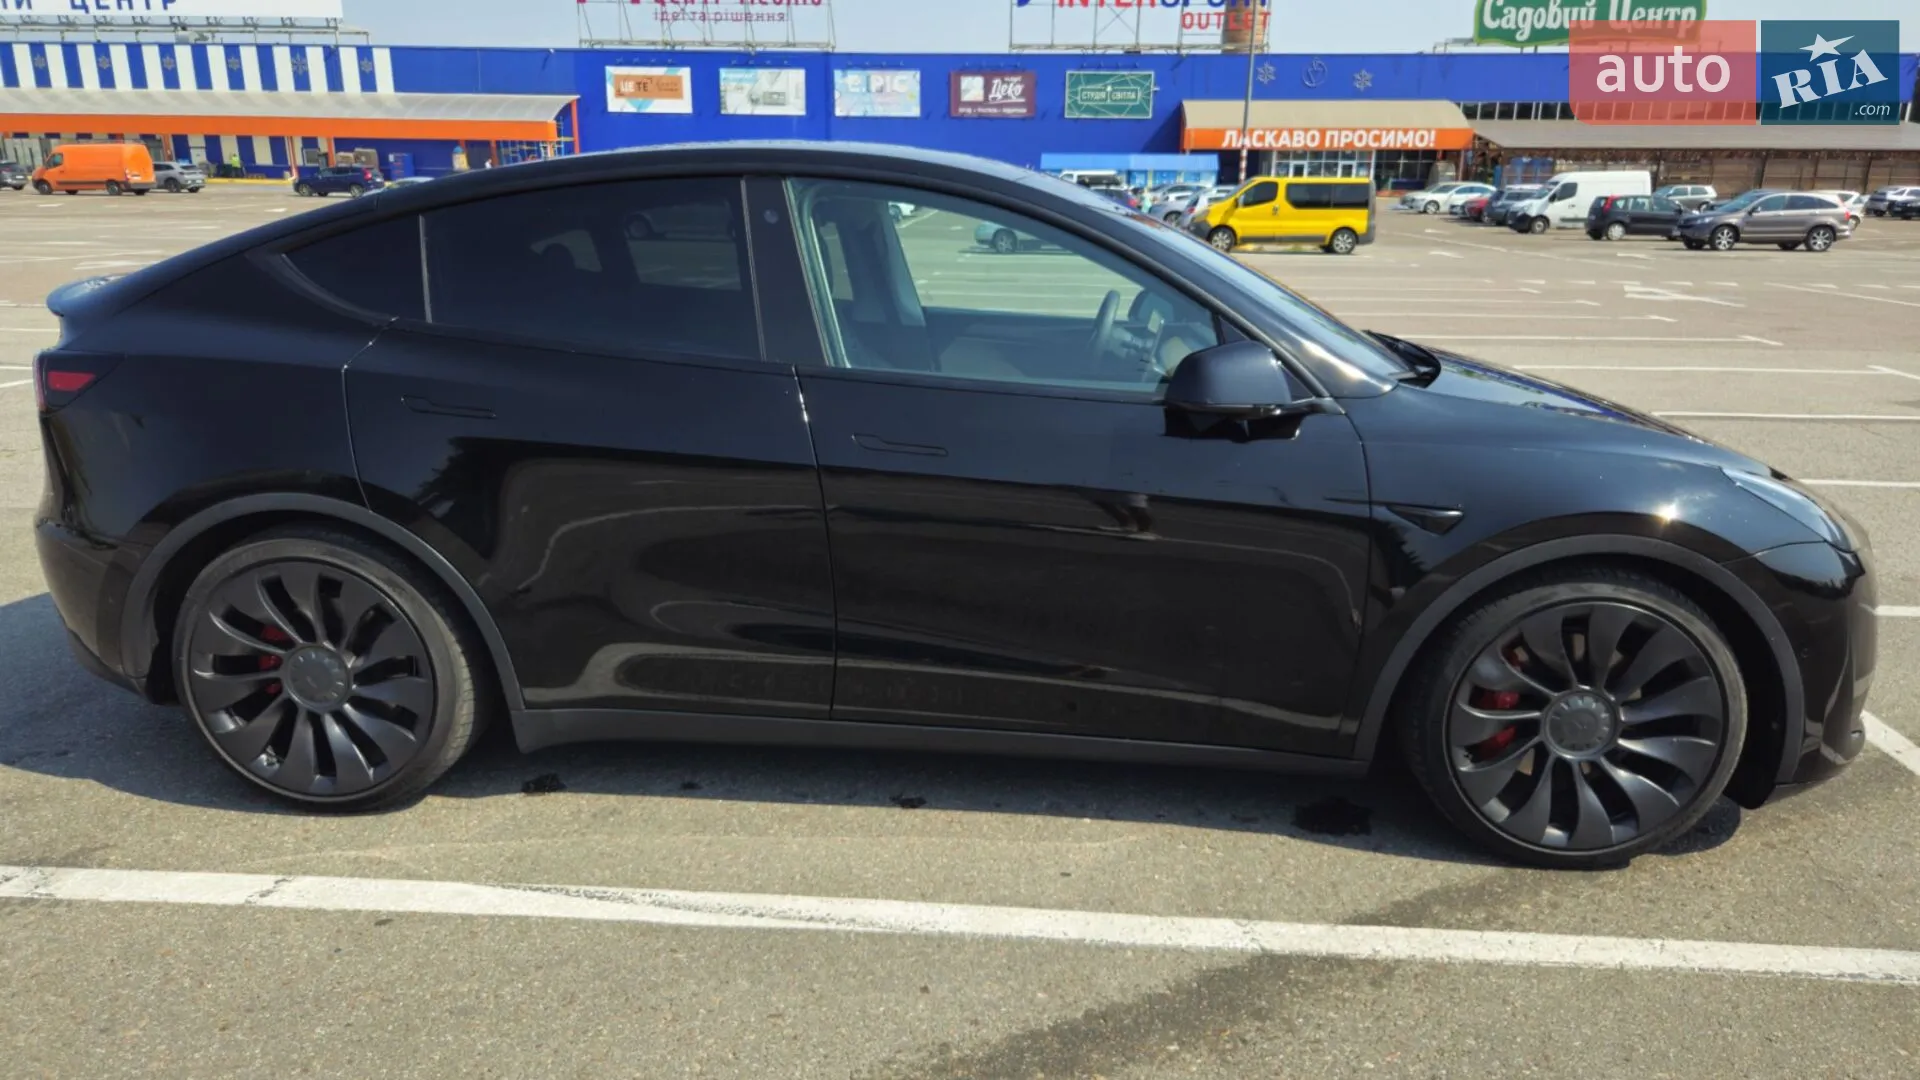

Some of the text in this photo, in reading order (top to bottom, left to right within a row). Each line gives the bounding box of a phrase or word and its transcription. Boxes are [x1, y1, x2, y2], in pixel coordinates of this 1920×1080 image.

[1181, 12, 1271, 30] OUTLET
[1608, 0, 1697, 38] Центр
[1222, 129, 1436, 149] ЛАСКАВО ПРОСИМО!
